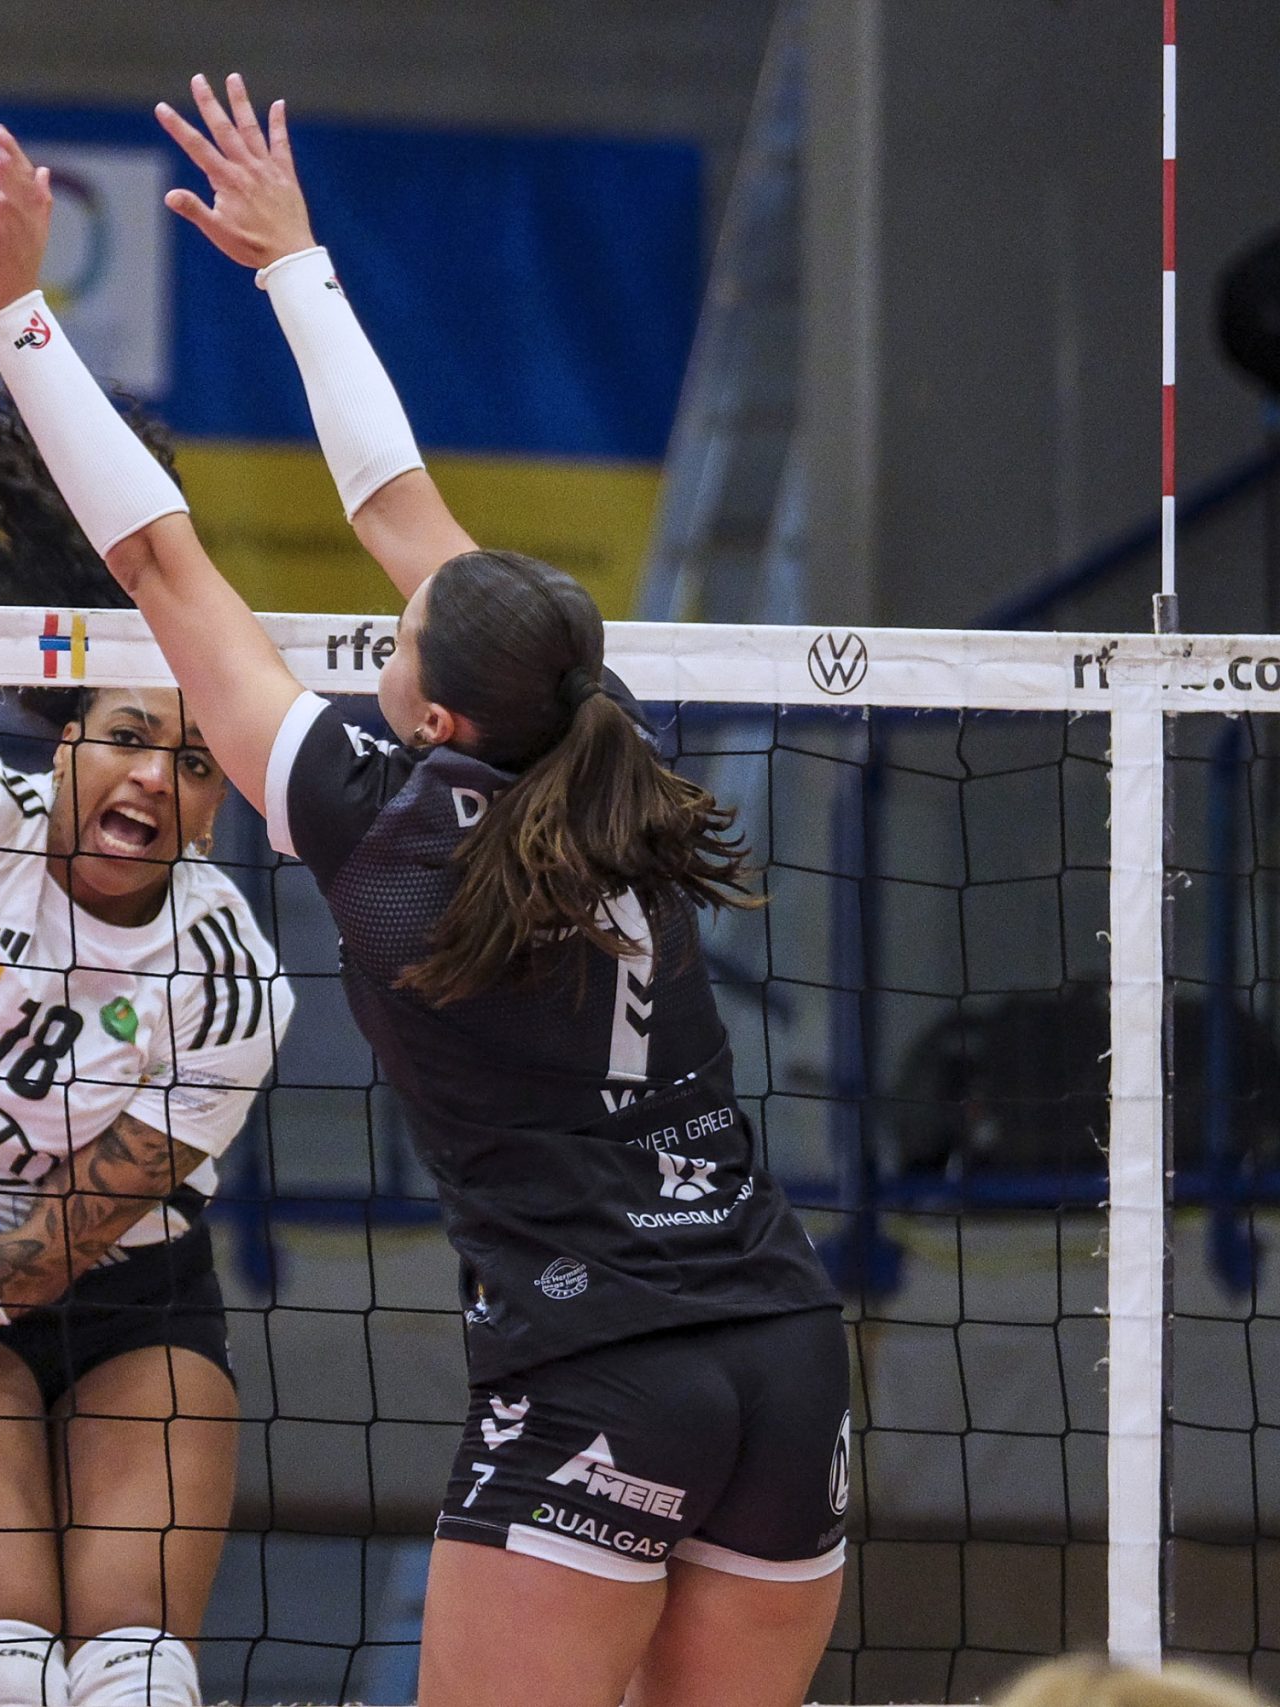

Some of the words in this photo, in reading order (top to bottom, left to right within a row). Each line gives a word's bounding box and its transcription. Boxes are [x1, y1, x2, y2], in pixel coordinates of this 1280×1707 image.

[462, 1462, 496, 1508] 7
[546, 1432, 687, 1521] AMETEL
[531, 1503, 668, 1558] DUALGAS
